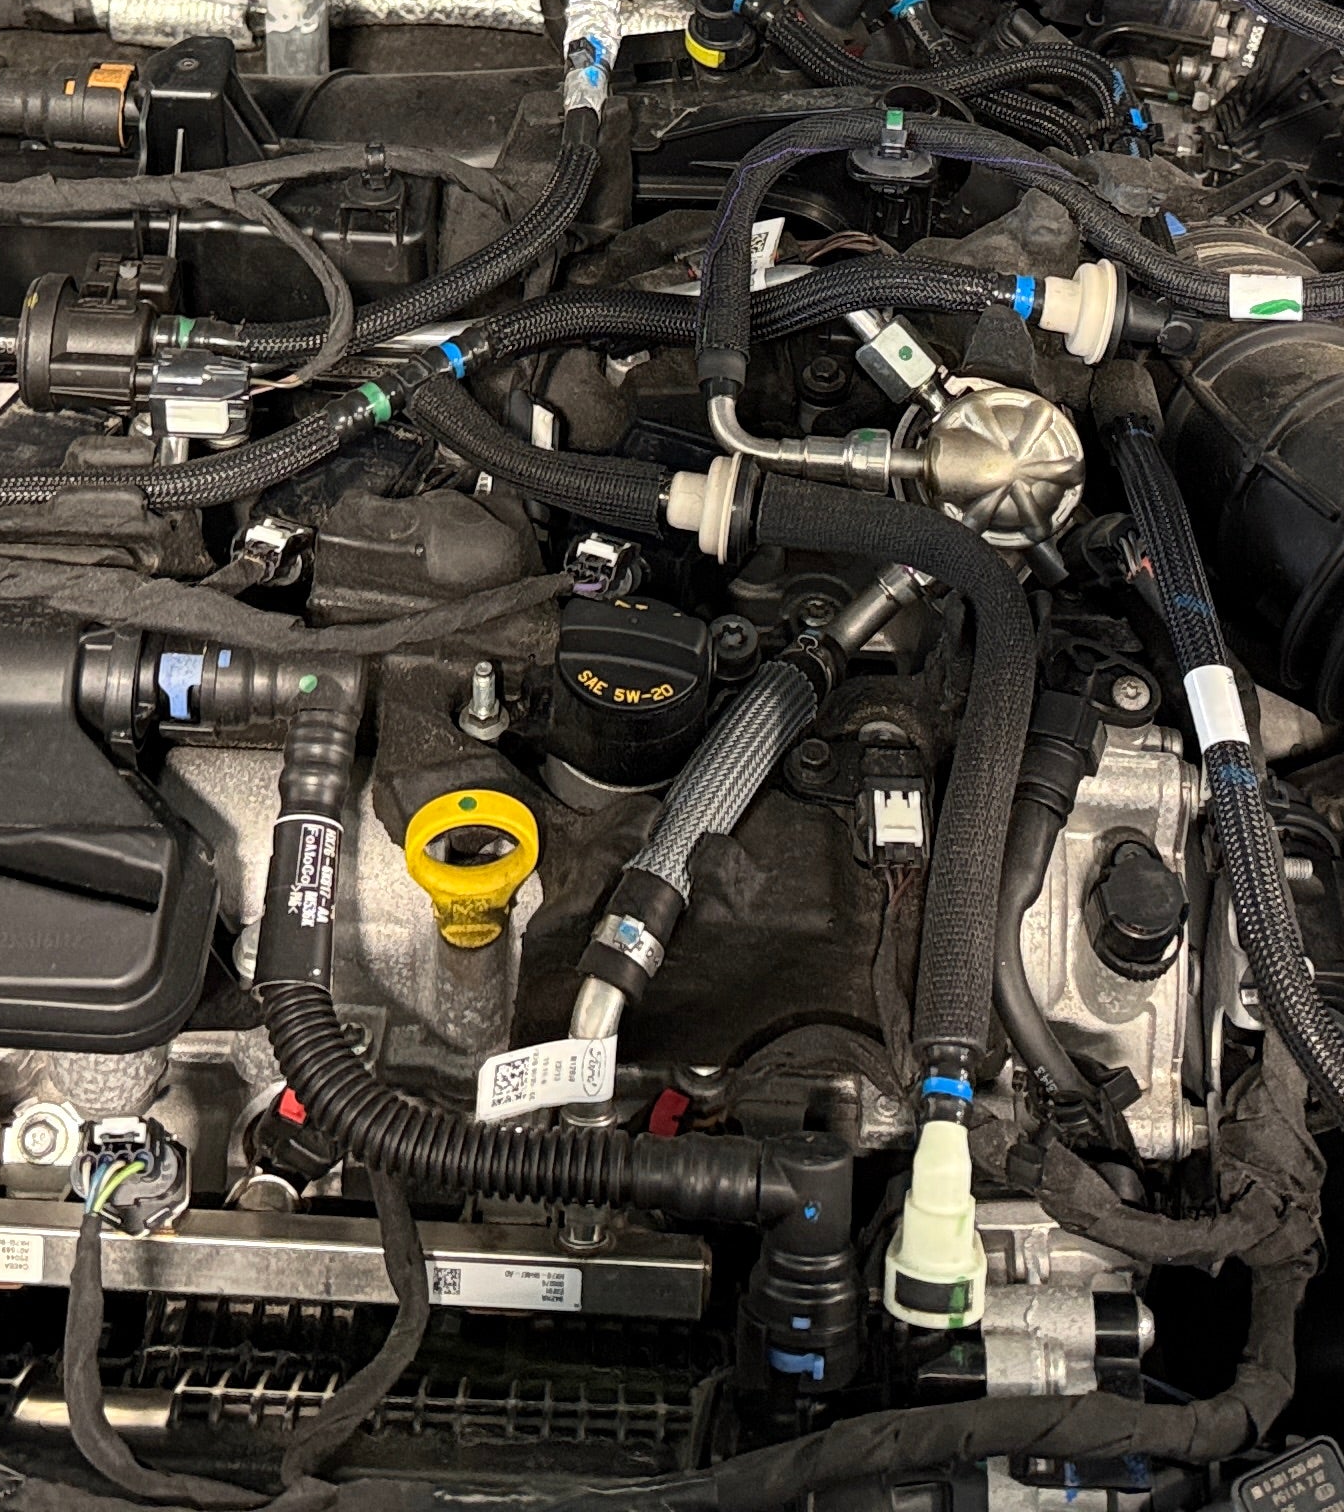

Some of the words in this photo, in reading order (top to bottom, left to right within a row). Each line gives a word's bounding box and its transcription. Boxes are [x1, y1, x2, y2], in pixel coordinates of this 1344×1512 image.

[578, 670, 608, 696] SAE
[613, 683, 674, 704] 5W-20
[300, 826, 318, 884] FoMoCo
